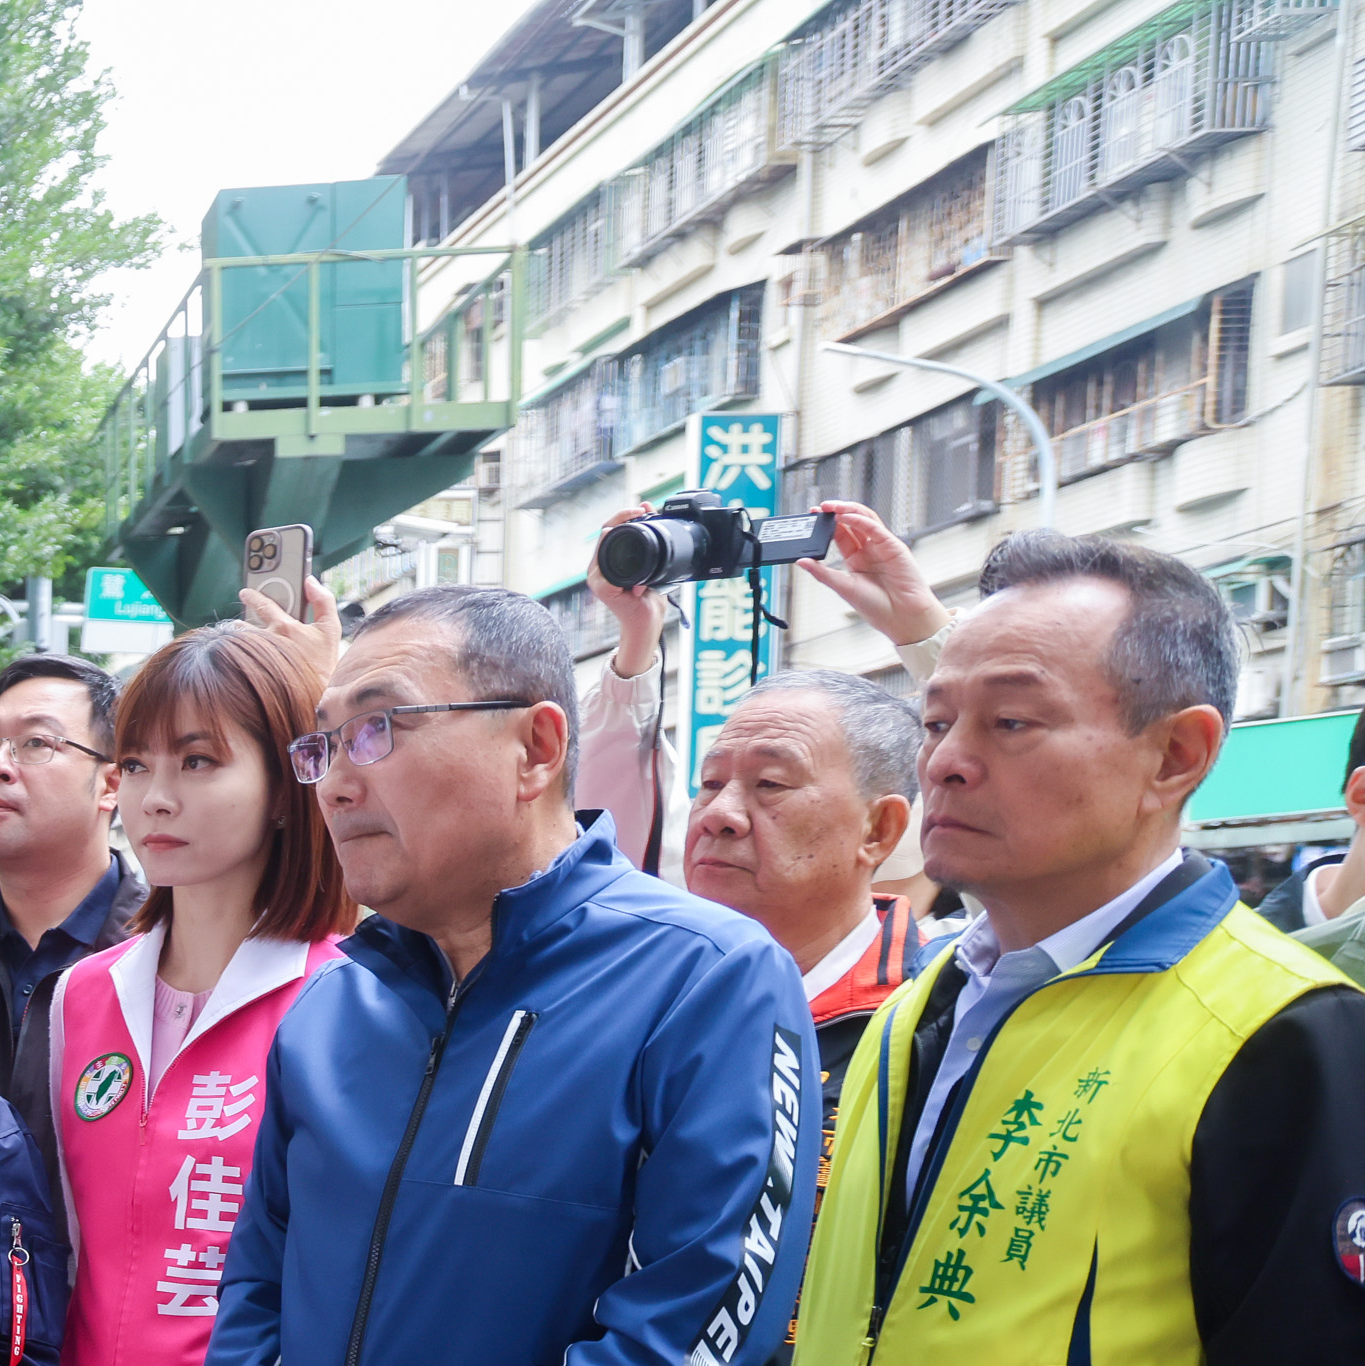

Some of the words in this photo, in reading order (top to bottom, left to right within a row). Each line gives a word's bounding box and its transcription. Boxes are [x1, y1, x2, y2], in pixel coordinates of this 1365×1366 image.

[691, 421, 775, 789] 洪能診
[157, 1070, 259, 1317] 彭佳芸
[772, 1032, 802, 1192] NEW
[917, 1089, 1044, 1321] 李余典
[999, 1067, 1111, 1271] 新北市議員
[14, 1274, 24, 1356] FIGHTING
